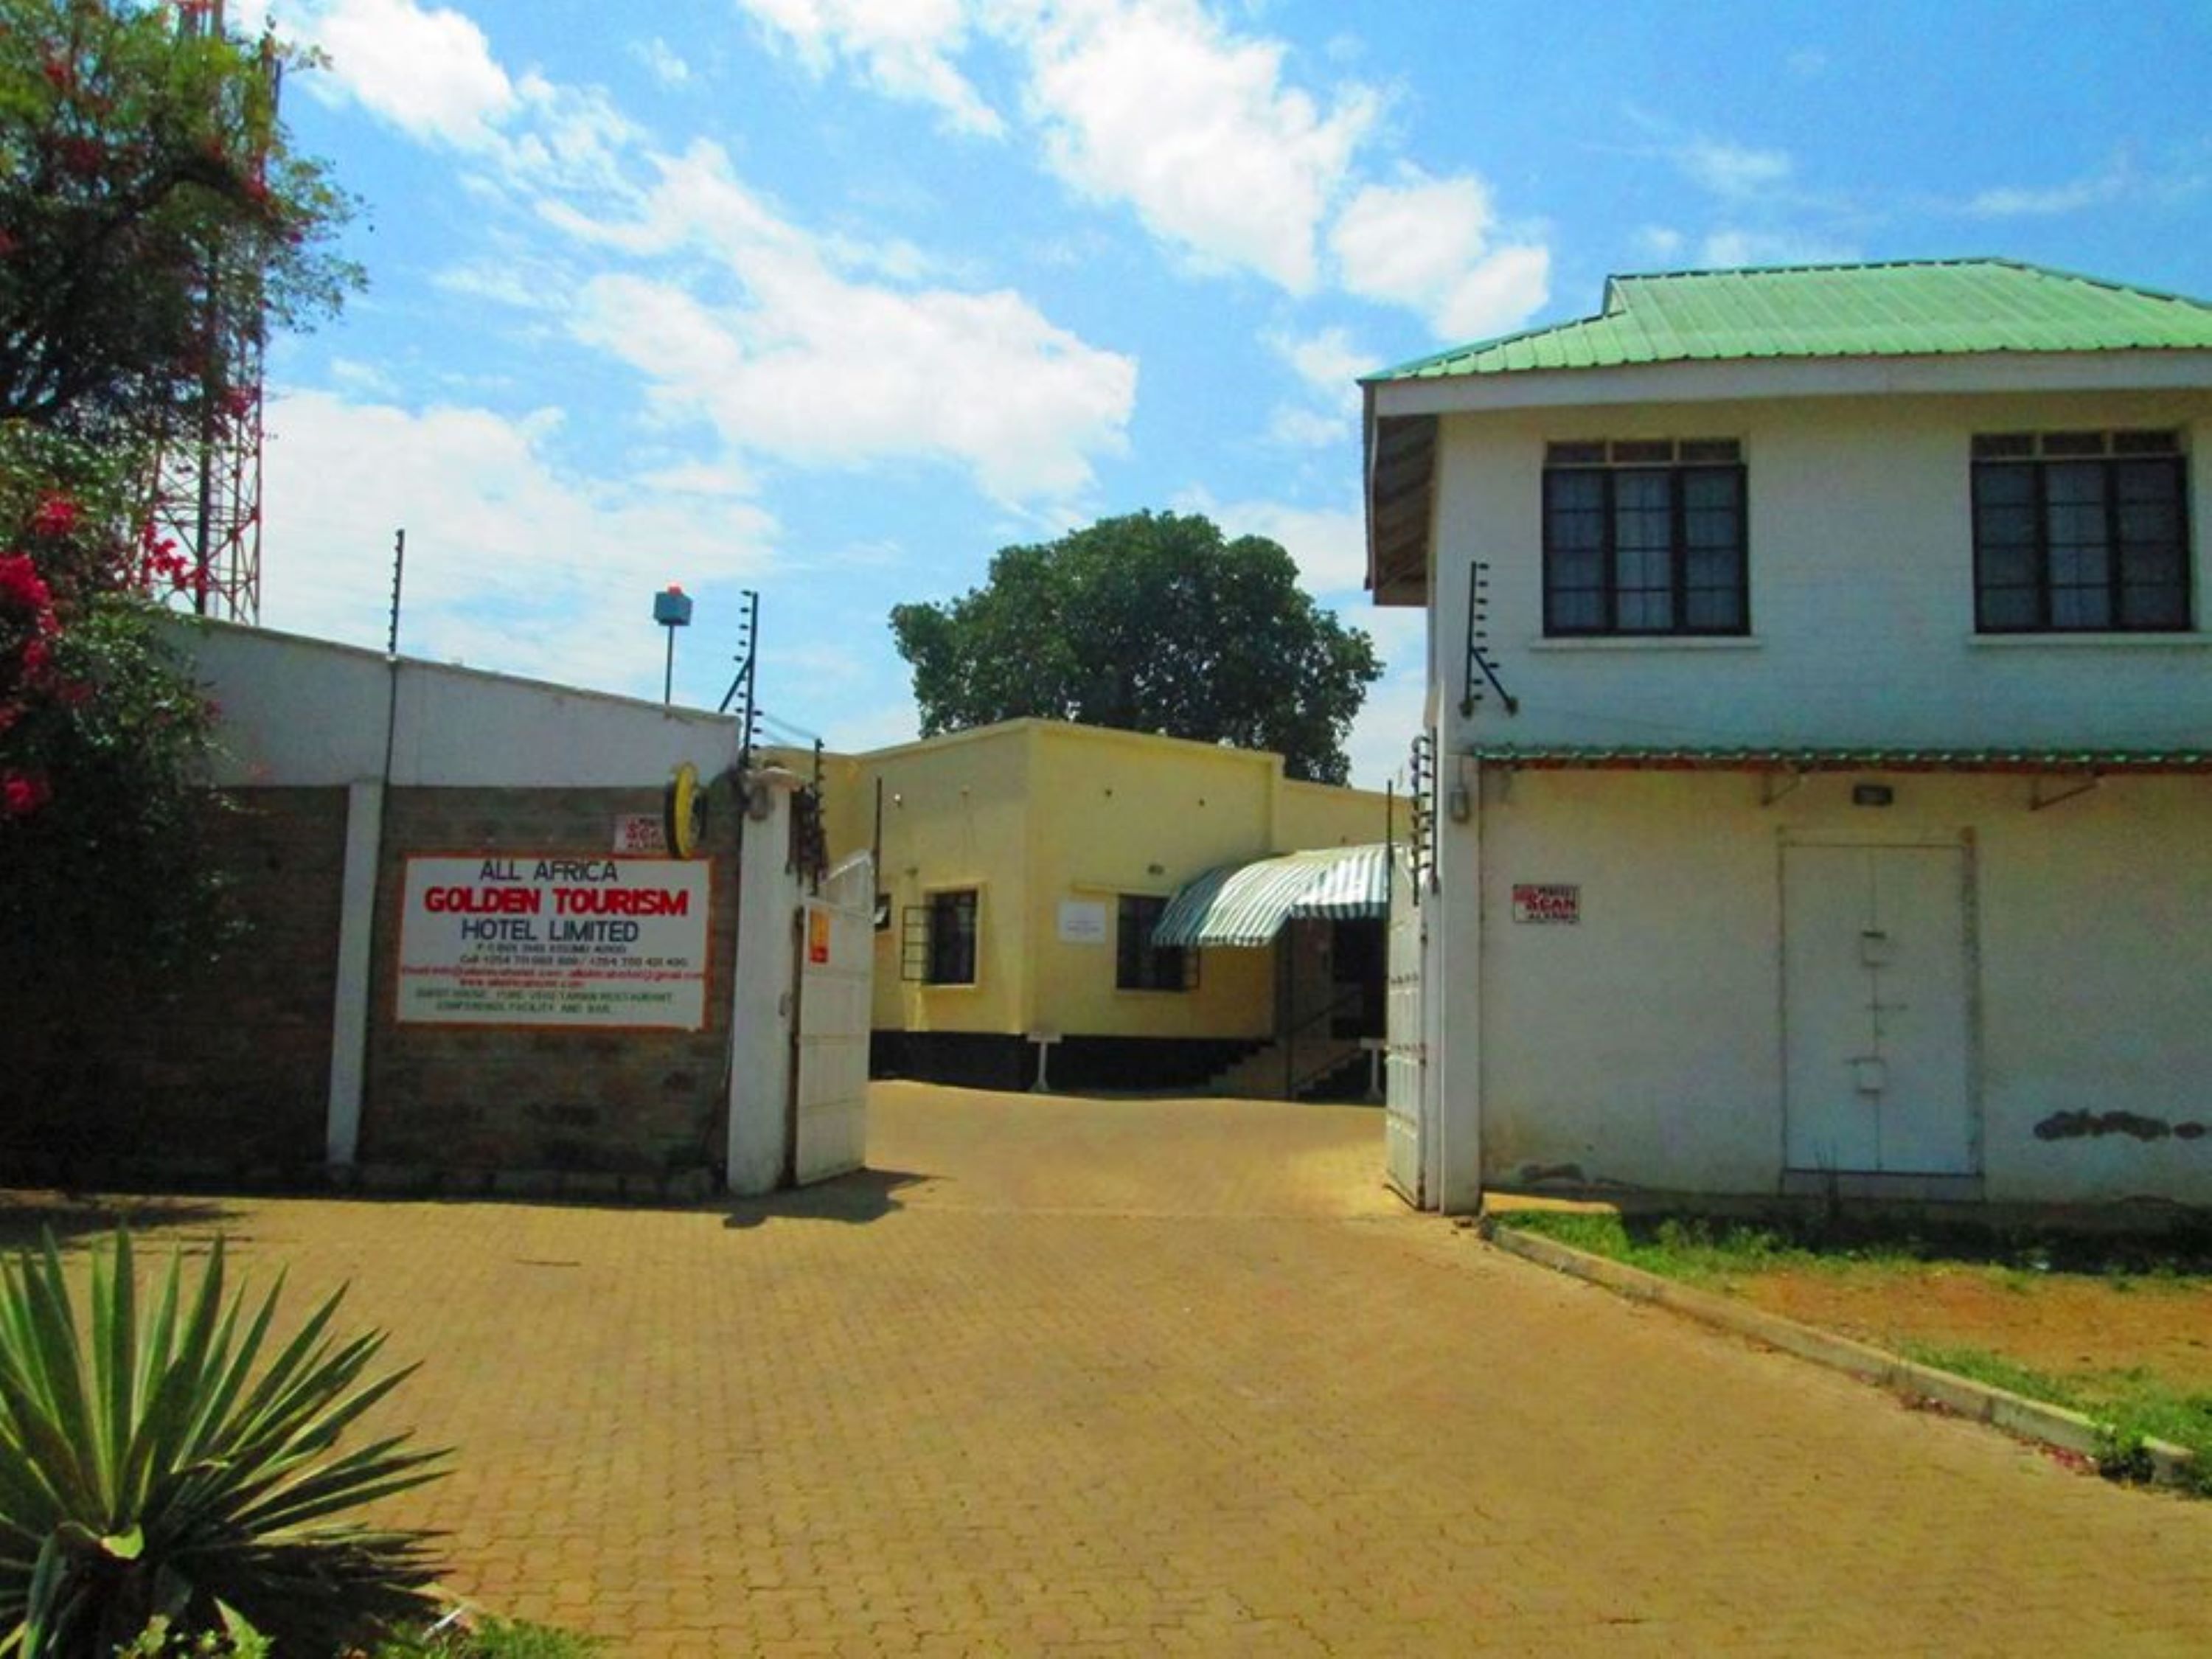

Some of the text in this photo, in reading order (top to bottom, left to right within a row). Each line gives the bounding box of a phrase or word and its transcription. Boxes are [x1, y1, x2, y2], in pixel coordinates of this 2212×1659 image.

[479, 860, 618, 882] ALL AFRICA
[425, 886, 689, 916] GOLDEN TOURISM
[462, 918, 639, 942] HOTEL LIMITED
